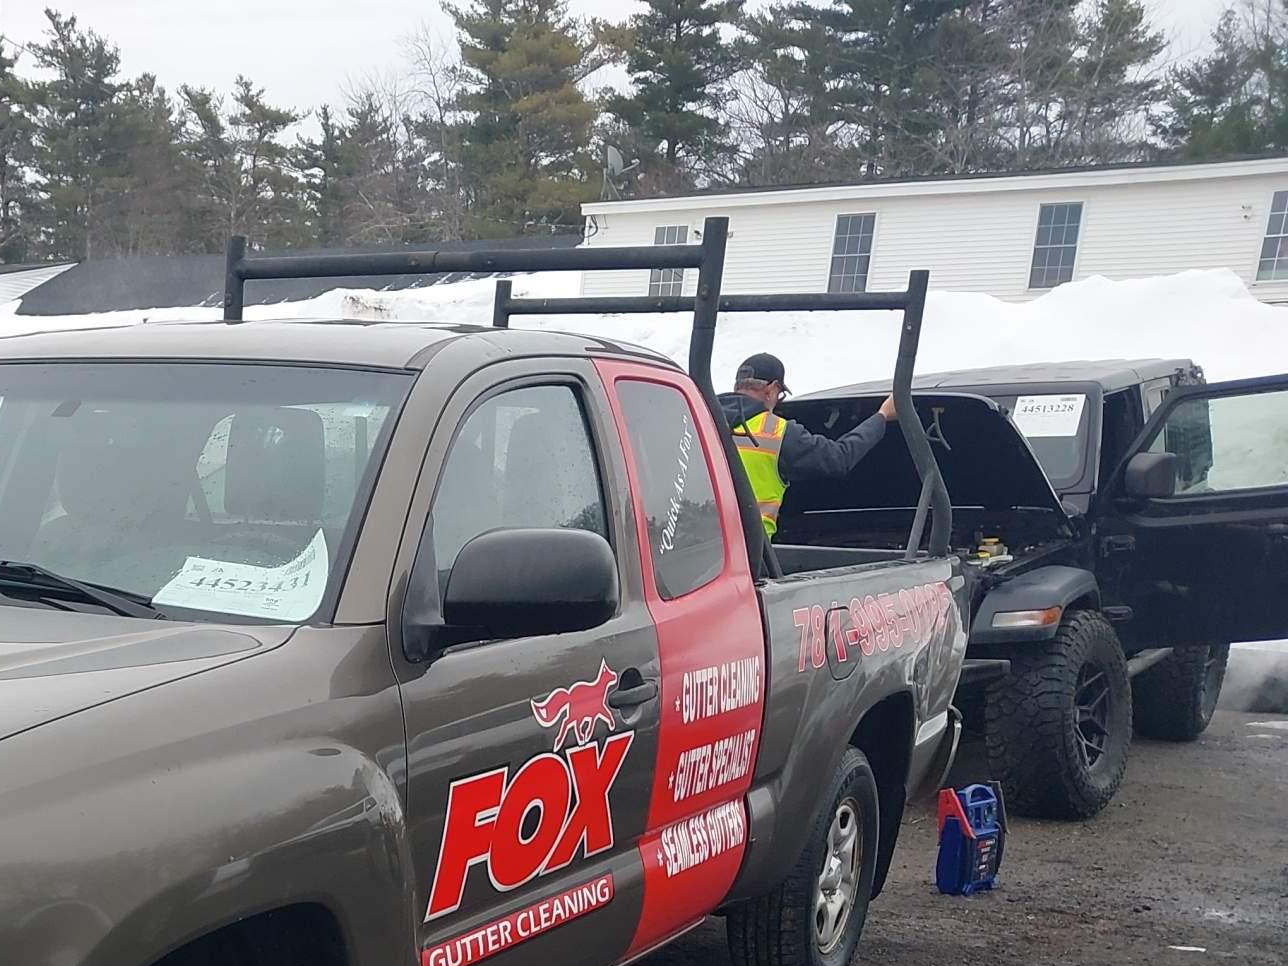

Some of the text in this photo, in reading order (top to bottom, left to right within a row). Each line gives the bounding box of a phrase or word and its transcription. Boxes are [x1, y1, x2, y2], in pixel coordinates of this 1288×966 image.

[1022, 403, 1075, 414] 44513228
[189, 570, 312, 593] 44523431
[682, 655, 760, 724] GUTTER CLEANING
[673, 729, 756, 803] GUTTER SPECIALIST
[423, 730, 635, 923] FOX
[661, 798, 744, 878] SEAMLESS GUTTERS
[516, 879, 610, 937] CLEANING
